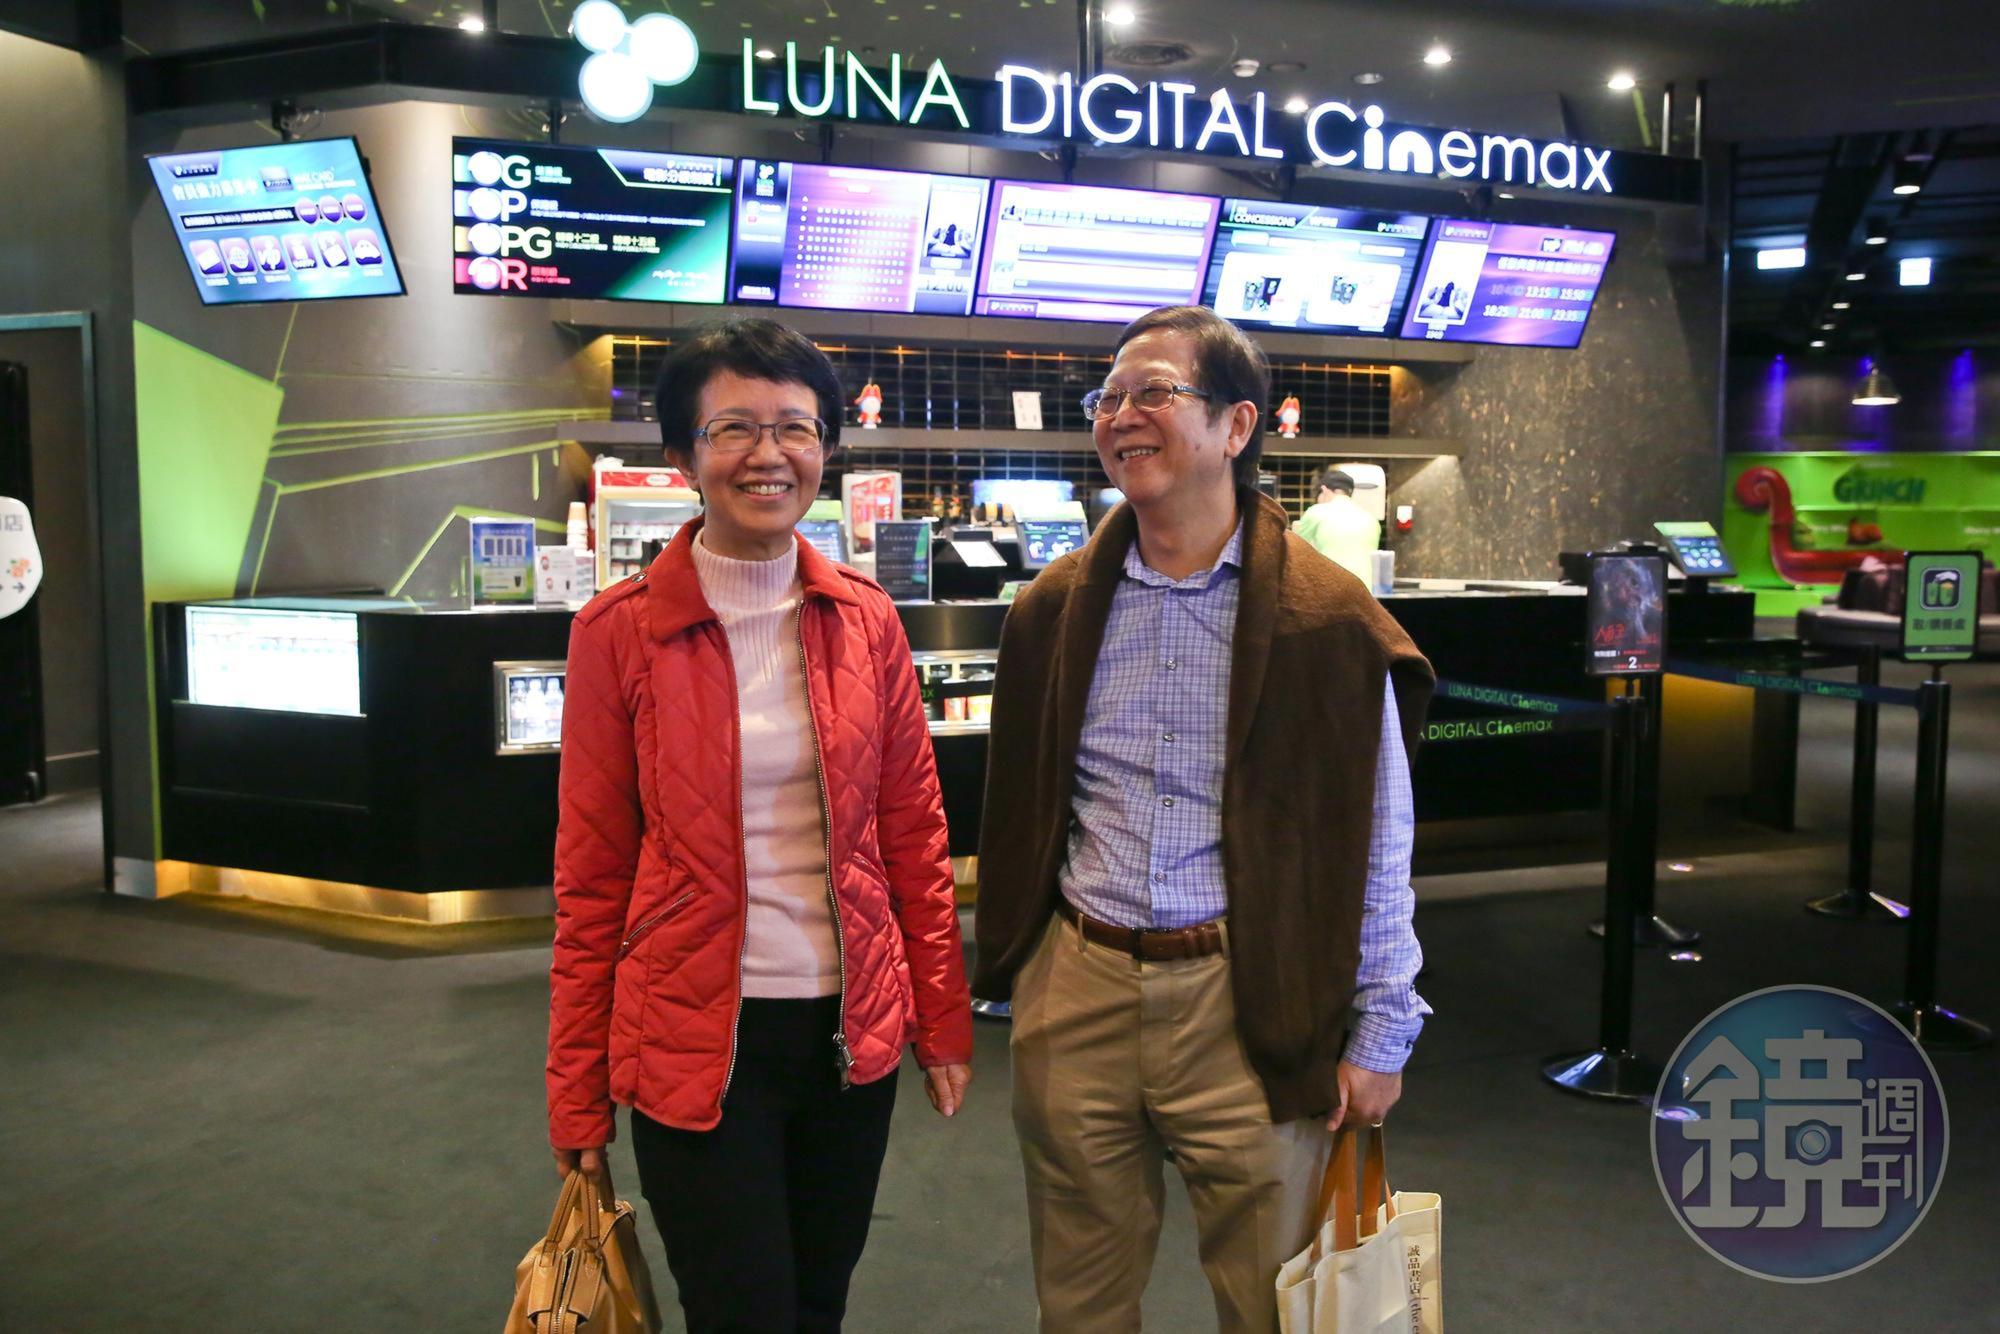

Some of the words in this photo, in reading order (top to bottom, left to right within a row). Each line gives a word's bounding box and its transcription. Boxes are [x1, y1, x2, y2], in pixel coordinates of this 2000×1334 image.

[741, 37, 970, 129] LUNA
[1000, 63, 1284, 159] DIGITAL
[1306, 101, 1613, 194] Cinemax
[500, 155, 532, 188] G
[500, 190, 528, 222] P
[500, 225, 552, 259] PG
[500, 258, 528, 291] R
[1628, 655, 1638, 669] 2
[1447, 682, 1472, 697] LUNA
[1474, 687, 1509, 706] DIGITAL
[1510, 693, 1560, 713] Cinemax
[1428, 722, 1483, 740] DIGITAL
[1486, 719, 1553, 735] Cinemax
[1410, 1302, 1422, 1323] the
